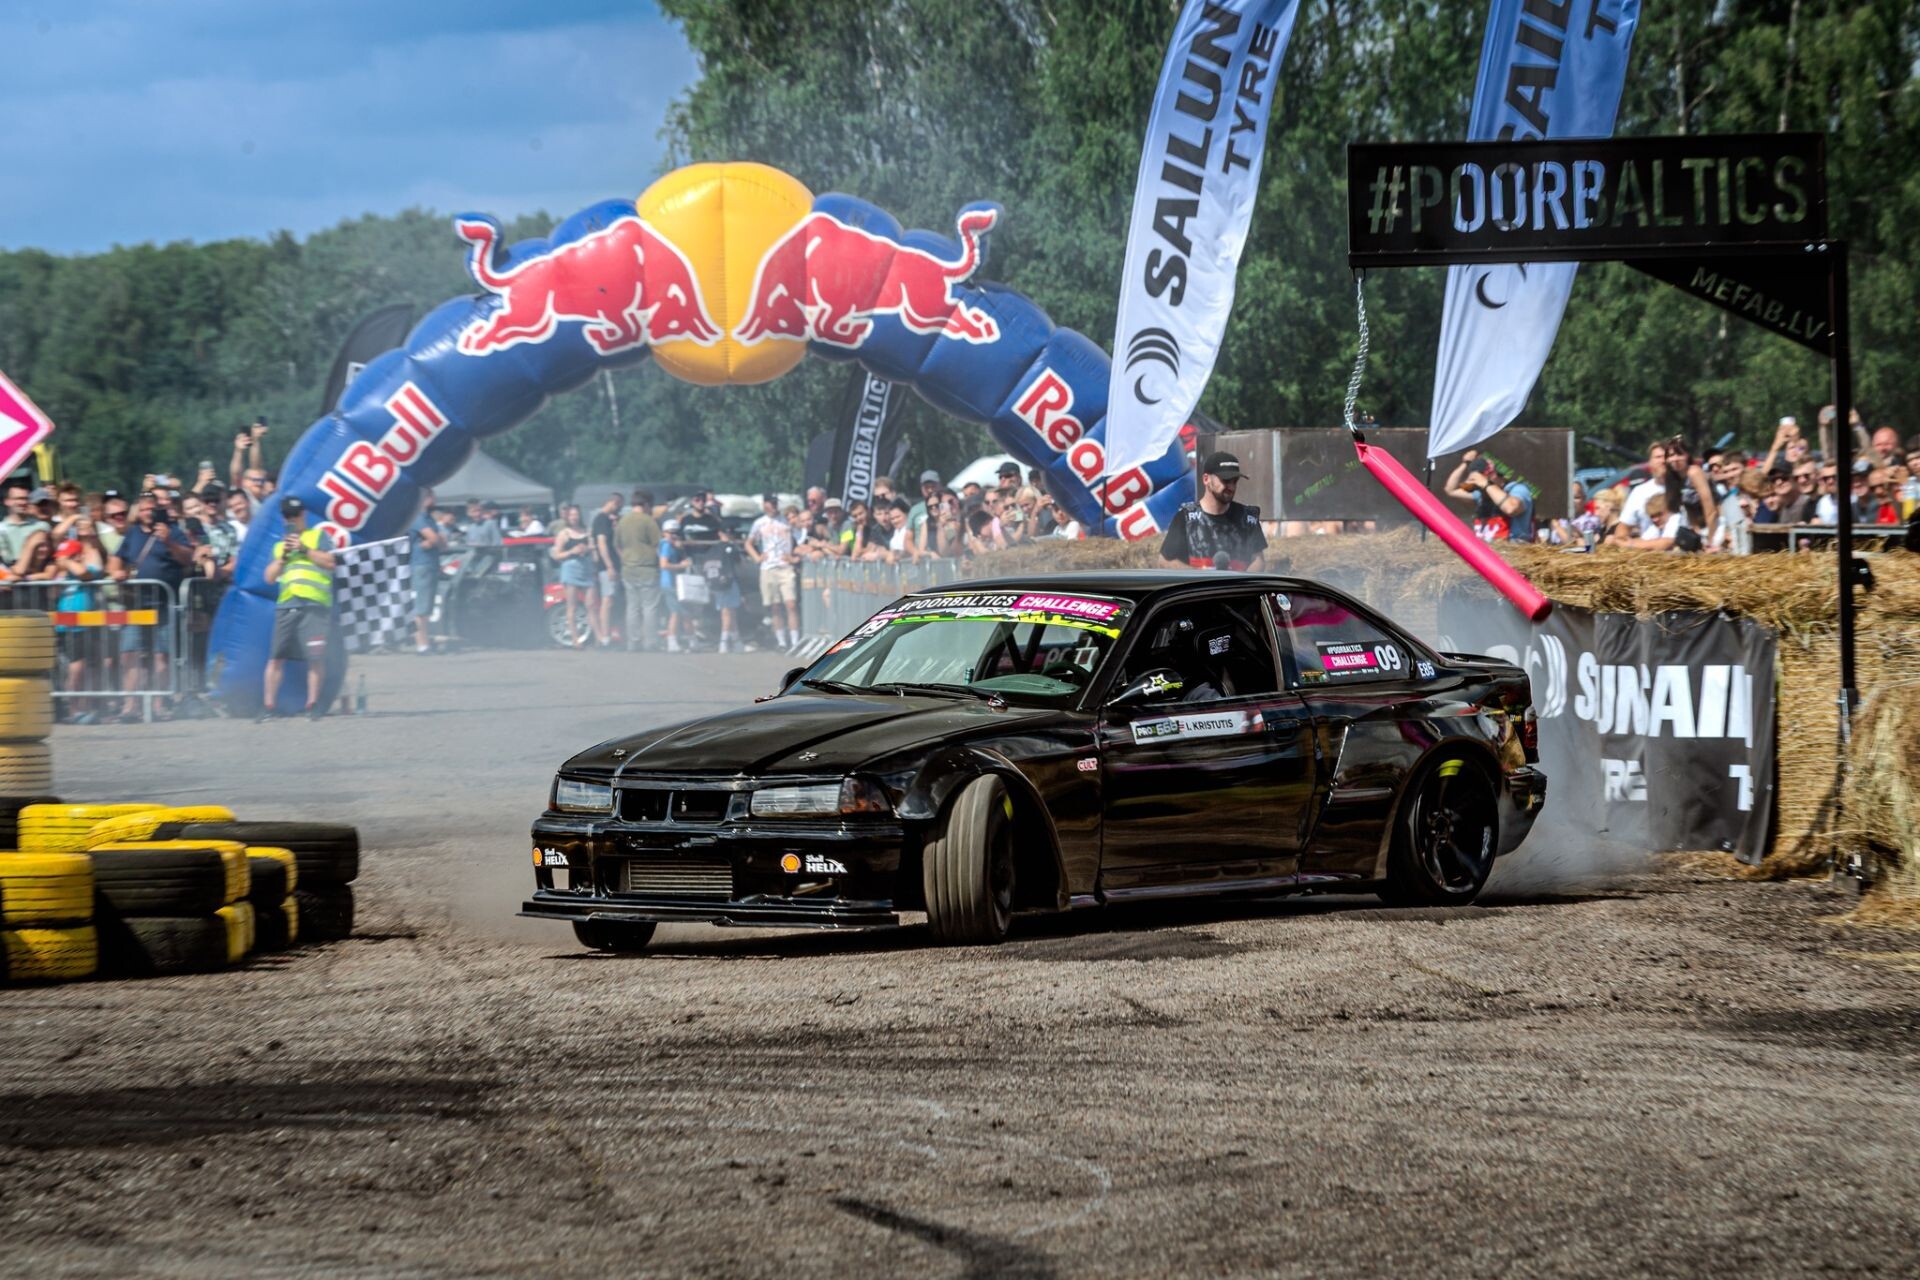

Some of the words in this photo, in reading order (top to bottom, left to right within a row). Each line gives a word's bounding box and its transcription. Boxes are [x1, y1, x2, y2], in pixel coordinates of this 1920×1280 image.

[1222, 20, 1279, 175] TYRE
[1144, 1, 1242, 307] SAILUN
[1367, 154, 1808, 235] #POORBALTICS
[1690, 265, 1827, 341] MEFAB.LV
[337, 383, 447, 497] Bull
[846, 379, 887, 511] OORBALTIC
[1093, 466, 1158, 542] Bu
[1019, 596, 1113, 616] CHALLENGE
[854, 619, 889, 636] 09
[1331, 654, 1369, 667] CHALLENGE
[1374, 644, 1401, 671] 09
[1418, 662, 1435, 677] E85
[1193, 719, 1234, 730] KRISTUTIS
[545, 853, 569, 865] HELIX
[806, 861, 848, 873] HELIX
